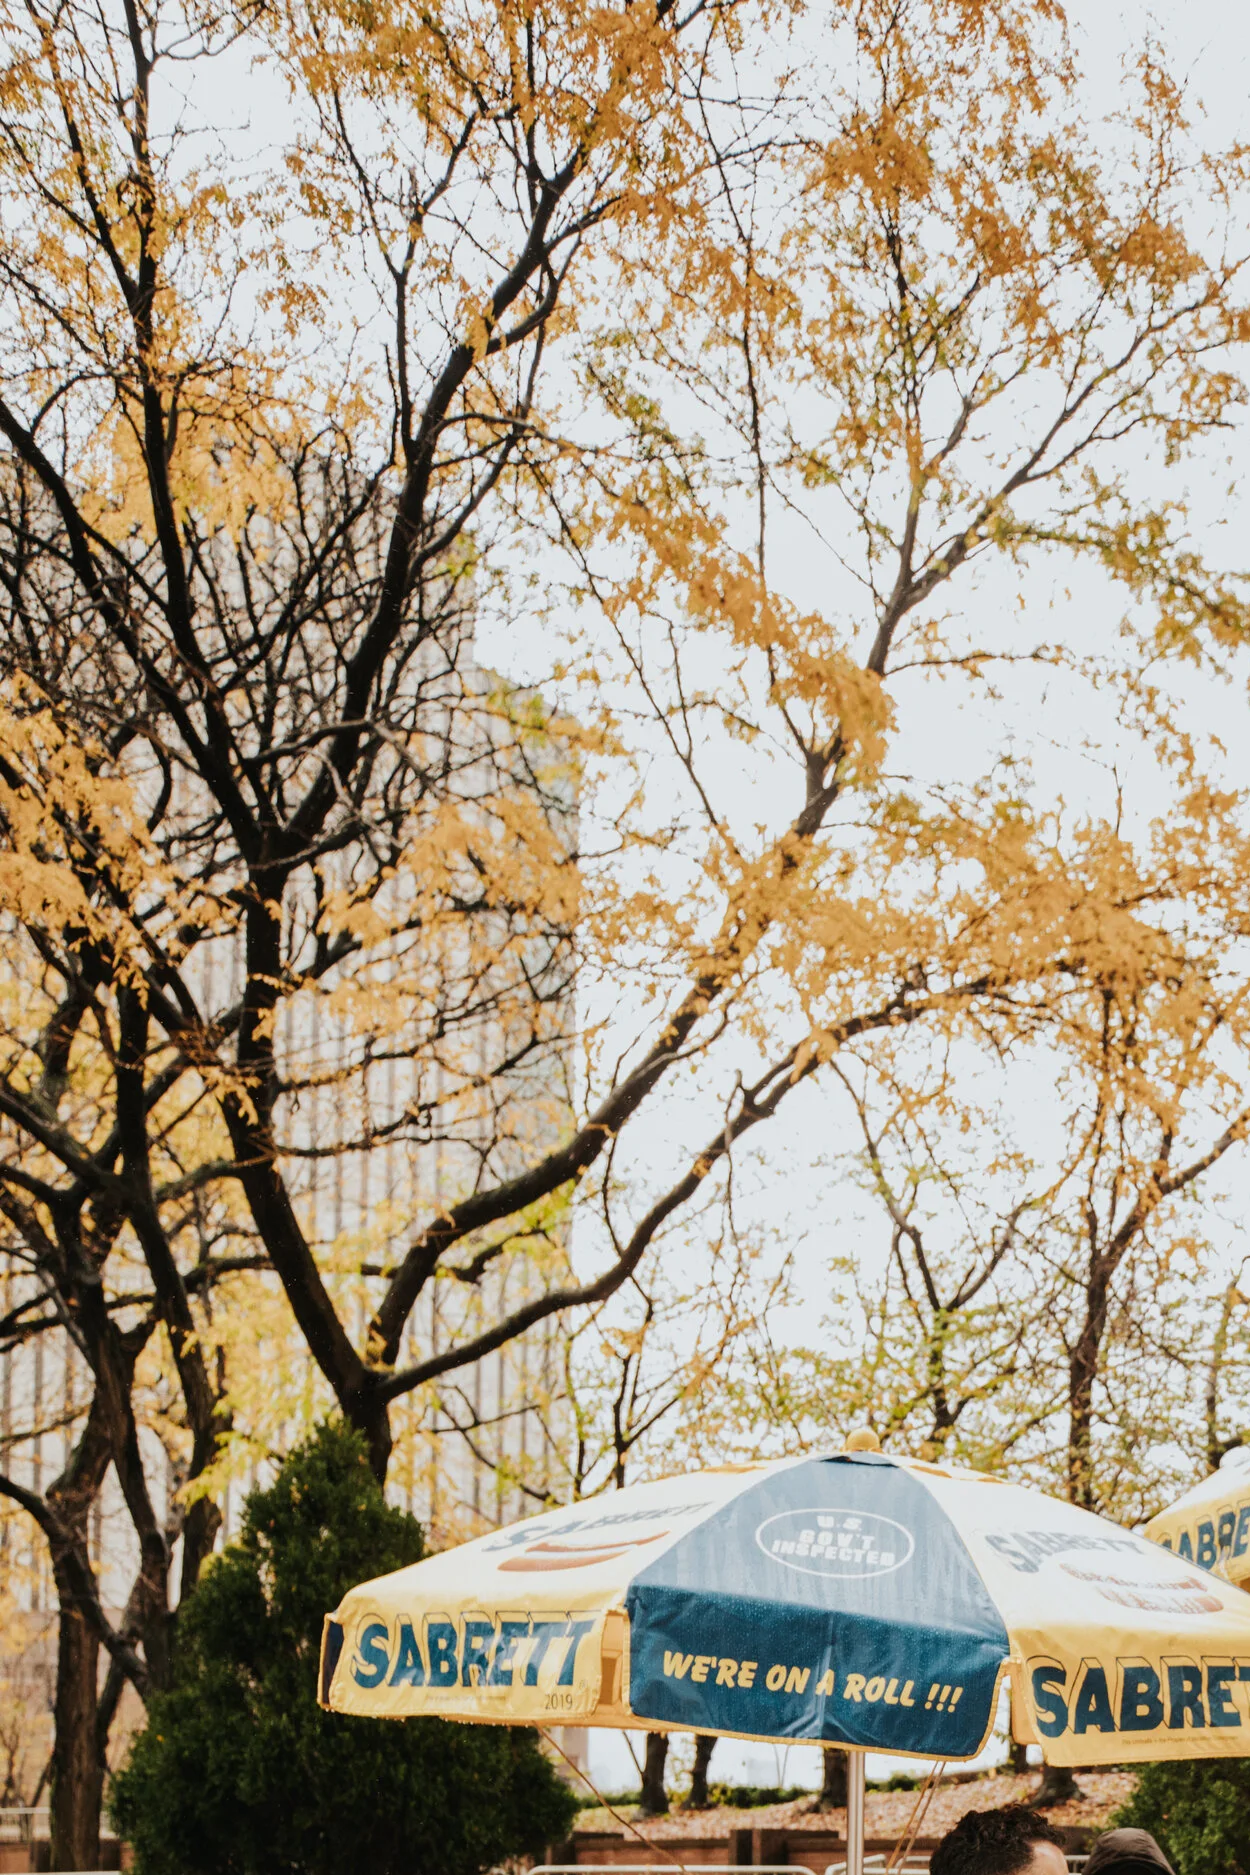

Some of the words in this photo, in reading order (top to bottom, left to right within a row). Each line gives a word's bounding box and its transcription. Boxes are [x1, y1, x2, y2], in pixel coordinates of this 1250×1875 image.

[816, 1515, 863, 1531] U.S.
[800, 1529, 876, 1550] GOV'T
[771, 1539, 896, 1567] INSPECTED
[350, 1611, 599, 1689] SABRETT
[662, 1650, 758, 1688] WE'RE
[765, 1664, 810, 1694] ON
[815, 1669, 835, 1696] A
[843, 1673, 915, 1707] ROLL
[924, 1683, 963, 1713] !!!
[544, 1693, 573, 1710] 2019
